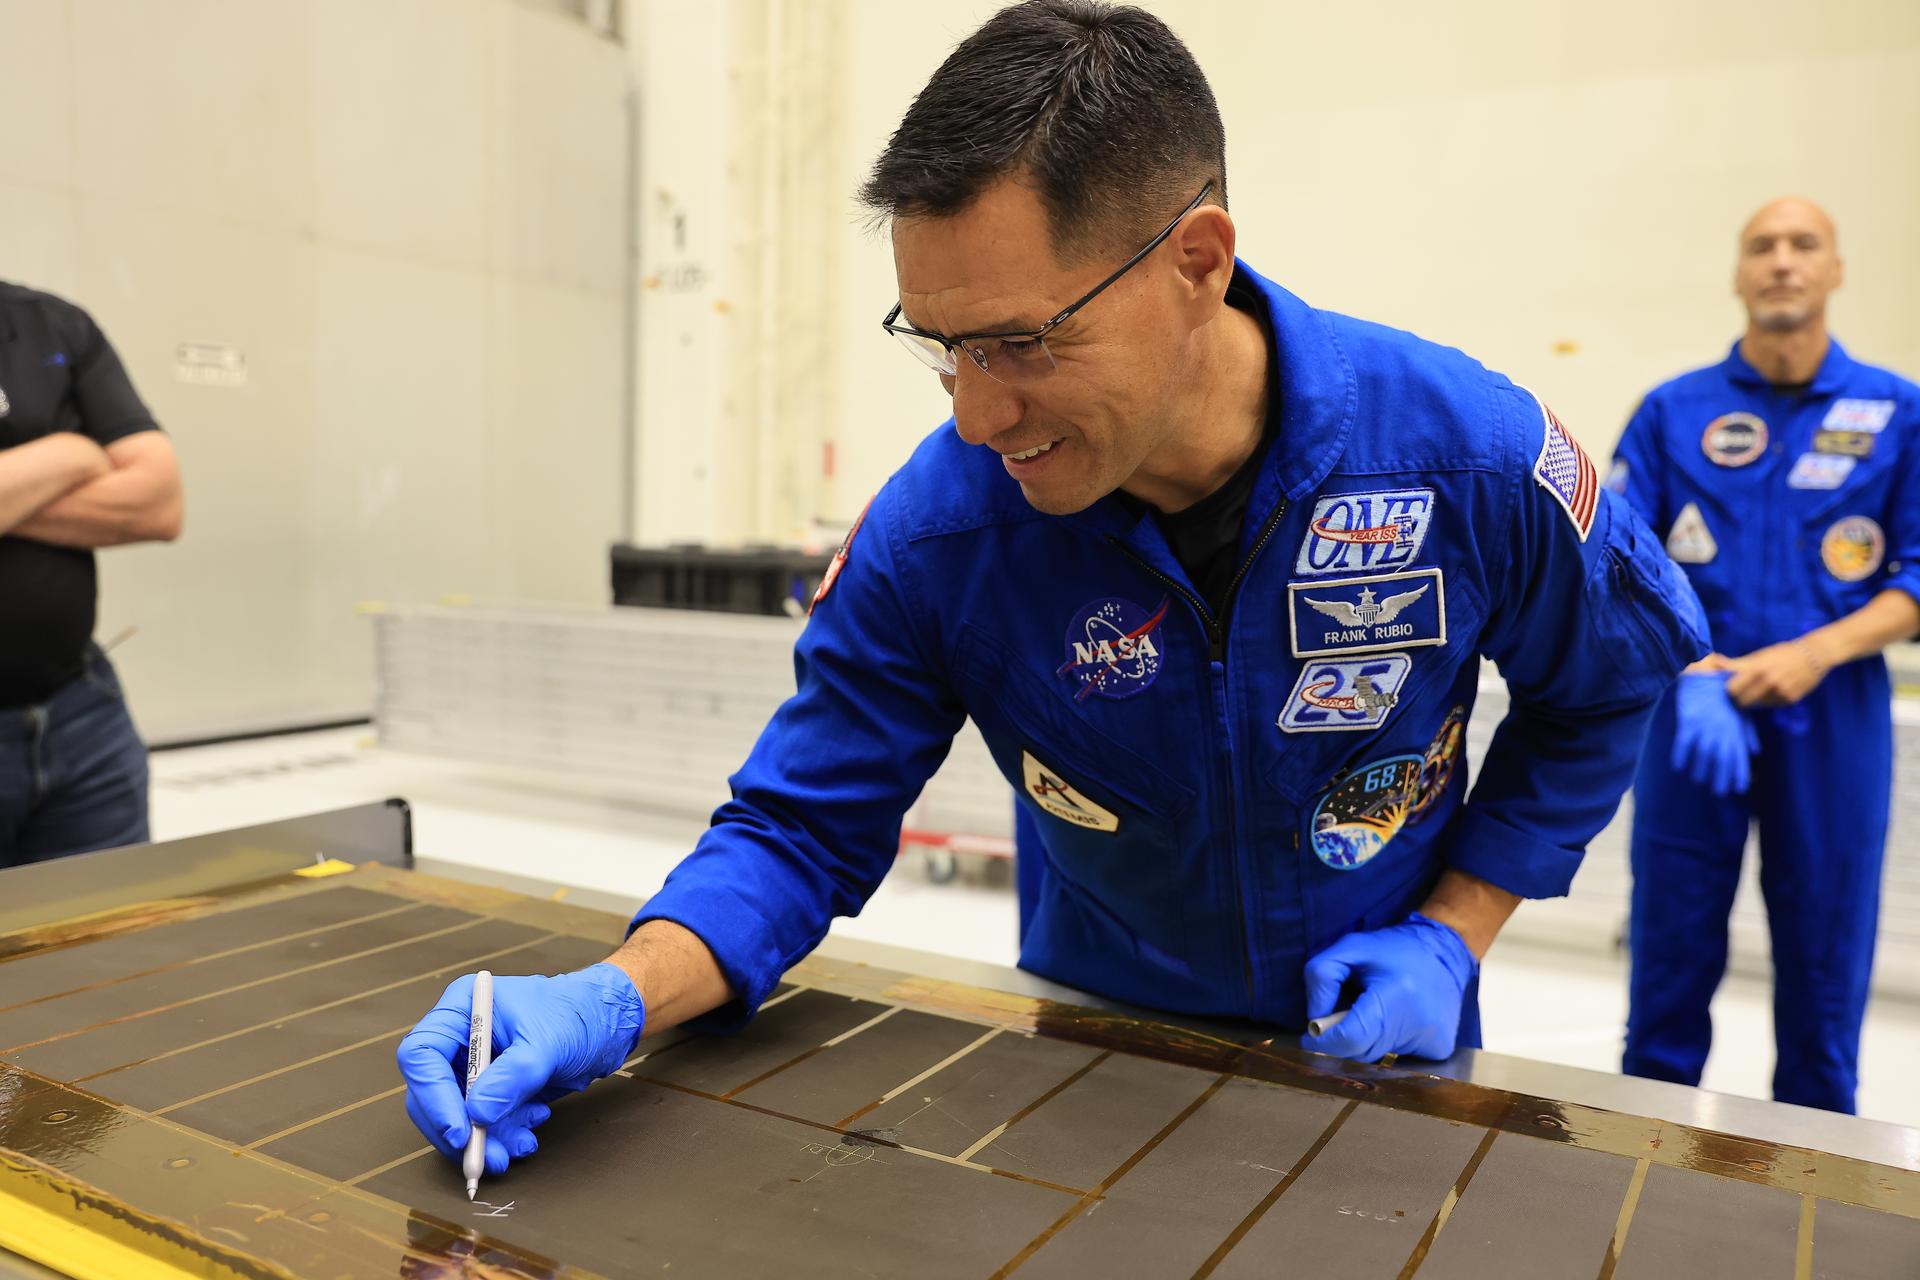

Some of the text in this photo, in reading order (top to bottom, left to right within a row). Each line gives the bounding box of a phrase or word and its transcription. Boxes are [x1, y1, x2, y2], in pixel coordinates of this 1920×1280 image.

[1308, 494, 1430, 570] ONE
[1350, 528, 1397, 541] YEAR ISS
[1324, 623, 1413, 644] FRANK RUBIO
[1071, 634, 1159, 665] NASA
[1293, 663, 1391, 722] 25
[1363, 763, 1398, 793] 68
[468, 1037, 479, 1076] Sharpie
